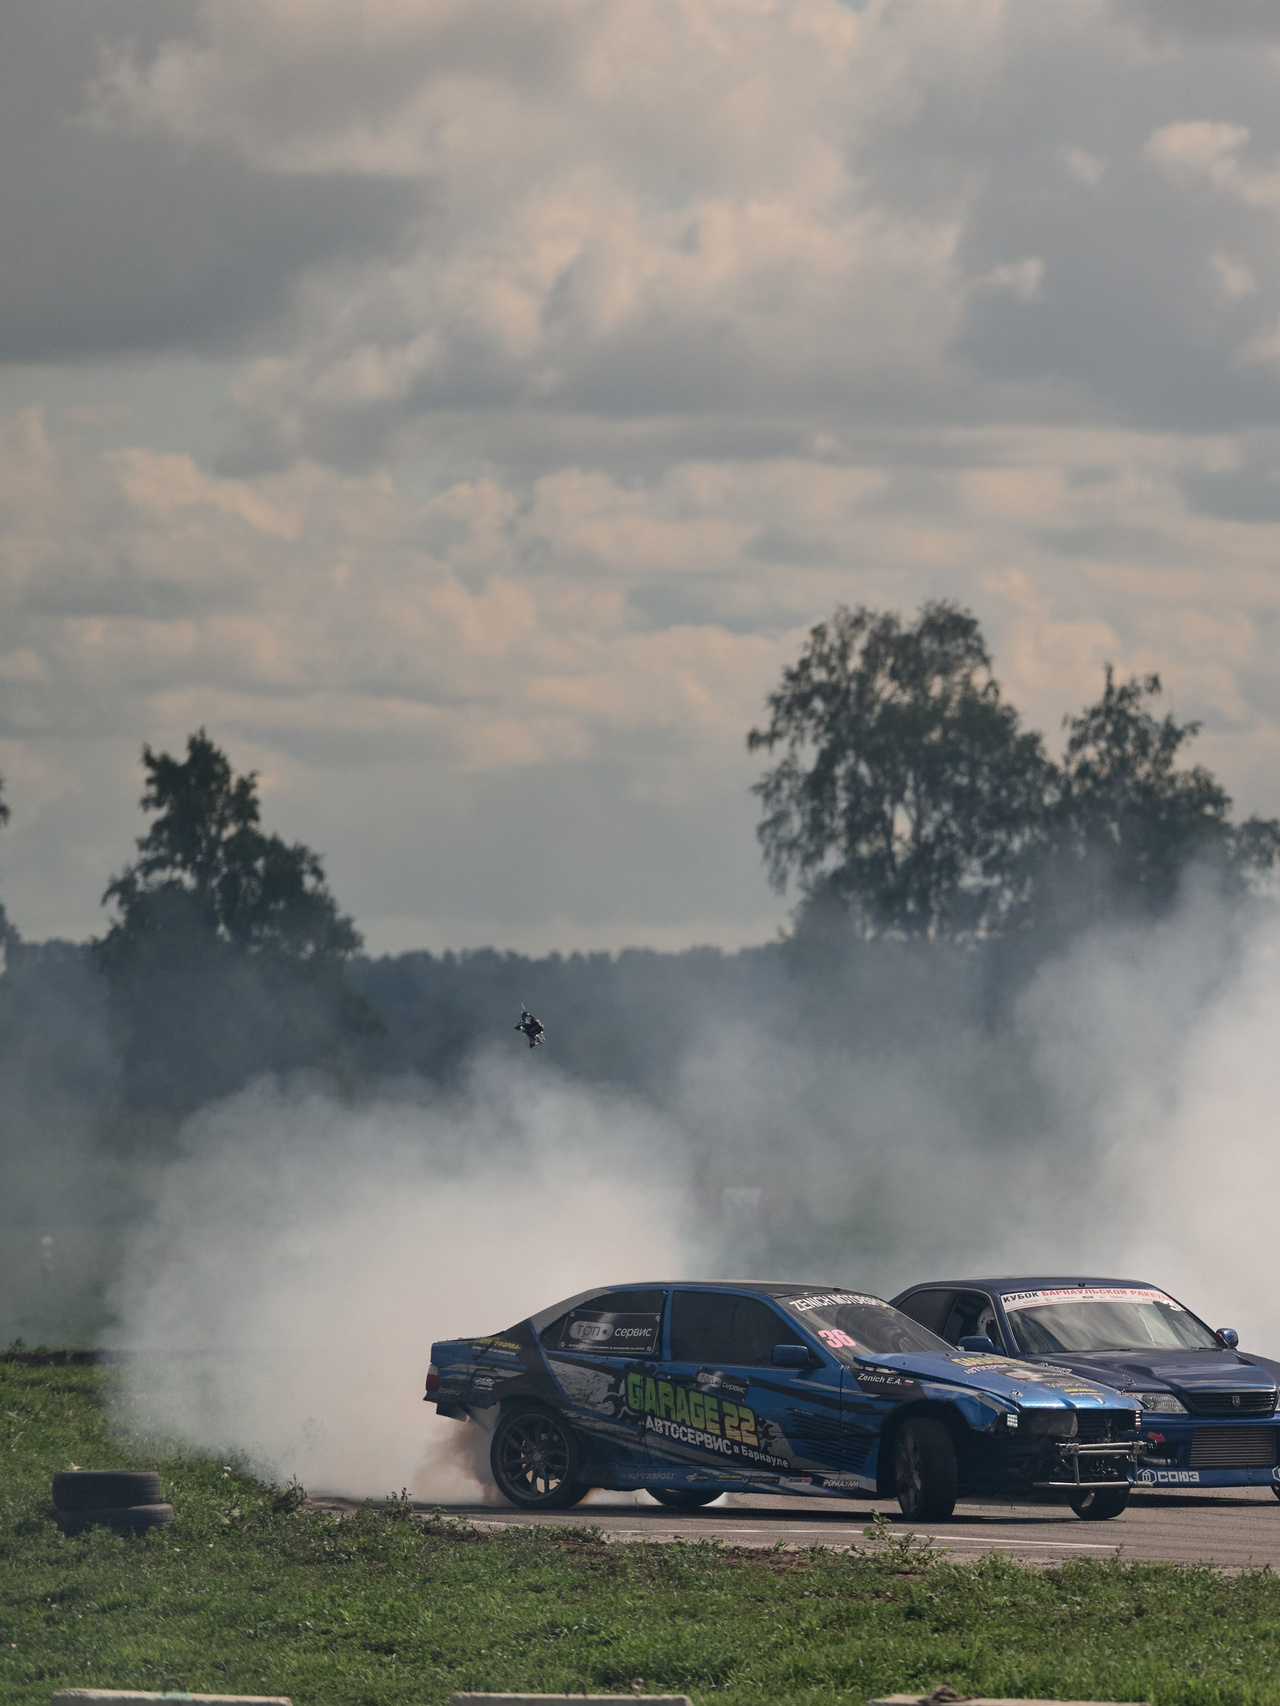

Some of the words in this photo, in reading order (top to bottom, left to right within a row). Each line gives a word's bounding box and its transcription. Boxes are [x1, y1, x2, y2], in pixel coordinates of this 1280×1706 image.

[789, 1294, 833, 1311] ZENICH
[1003, 1291, 1039, 1303] КУБОК
[1041, 1288, 1127, 1297] БАРНАУЛЬСКОЙ
[614, 1327, 652, 1338] сервис
[818, 1329, 856, 1348] 36
[857, 1373, 885, 1384] Zenich
[886, 1377, 902, 1385] E.A.
[722, 1381, 746, 1394] сервис
[627, 1372, 721, 1435] GARAGE
[722, 1401, 759, 1446] 22
[645, 1415, 733, 1455] АВТОСЕРВИС
[733, 1444, 740, 1454] в
[741, 1445, 790, 1468] Барнауле
[1157, 1471, 1200, 1483] СОЮЗ
